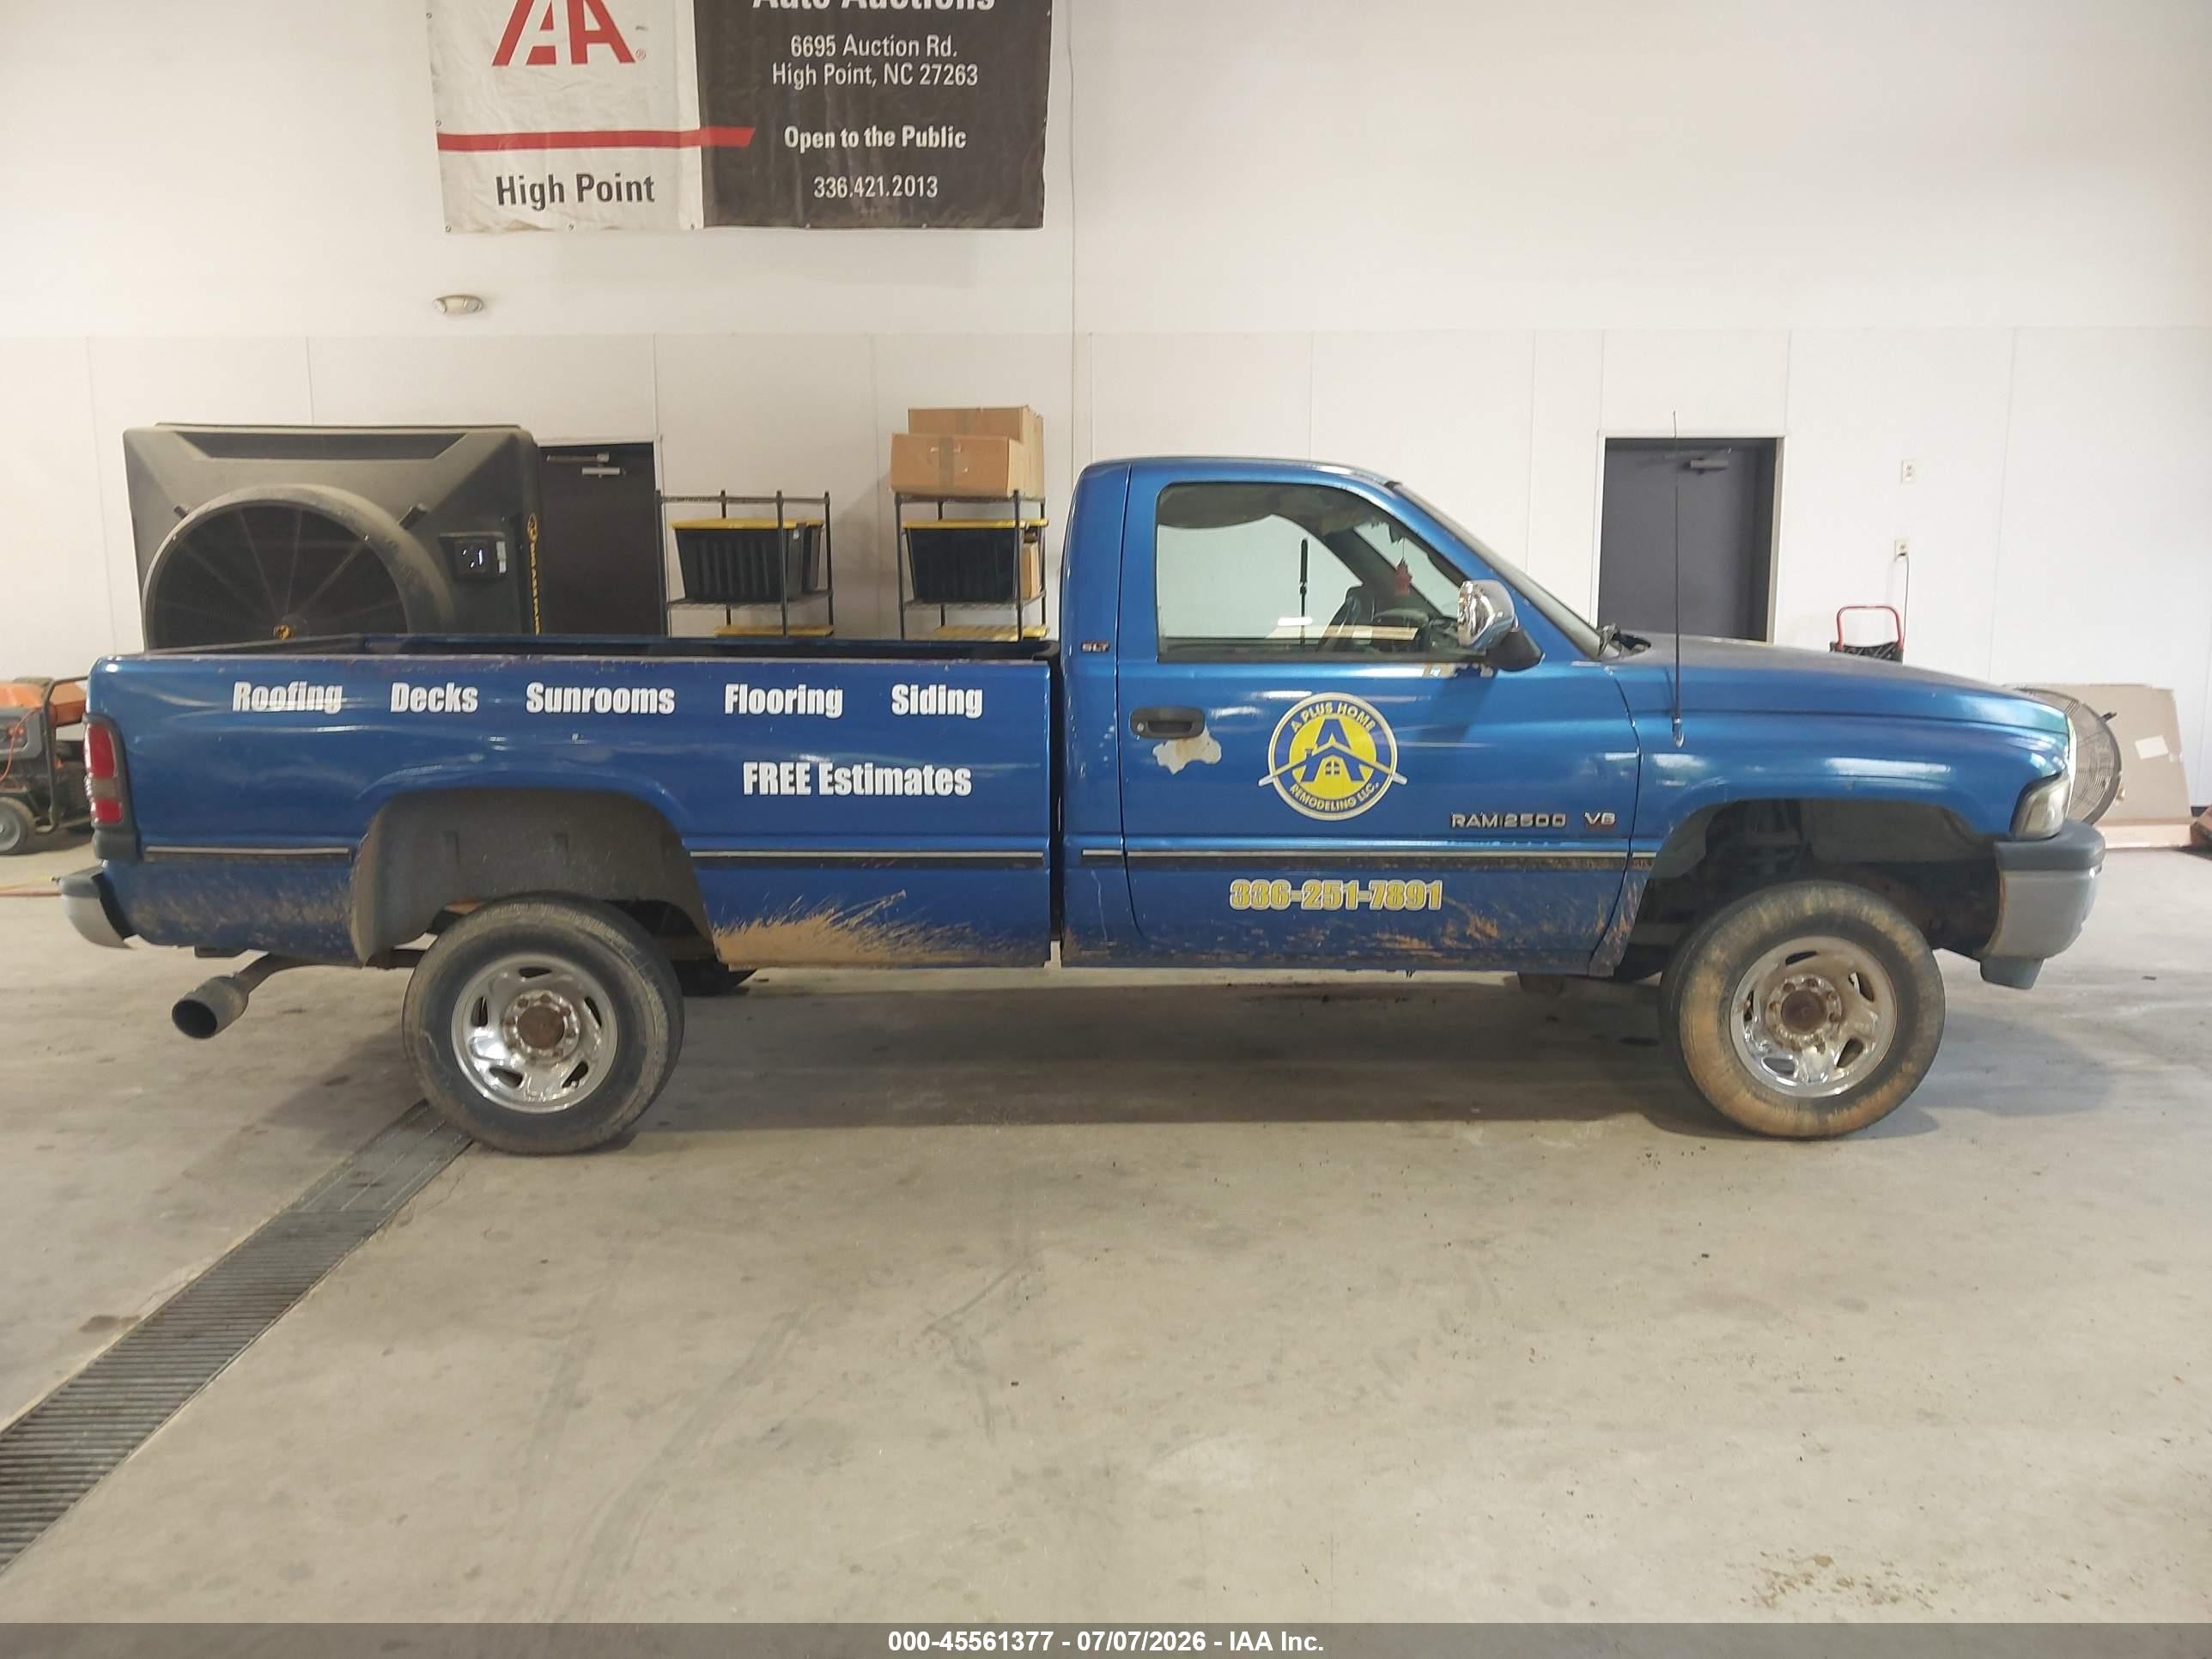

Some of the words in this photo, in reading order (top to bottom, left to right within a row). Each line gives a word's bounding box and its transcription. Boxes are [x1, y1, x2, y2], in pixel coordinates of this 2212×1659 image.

[790, 34, 836, 58] 6695
[842, 33, 920, 57] Auction
[926, 34, 957, 57] Rd.
[772, 62, 817, 90] High
[823, 62, 878, 88] Point,
[884, 62, 914, 85] NC
[919, 63, 978, 86] 27263
[784, 125, 836, 154] Open
[840, 128, 860, 148] to
[863, 125, 896, 148] the
[902, 125, 967, 149] Public
[495, 173, 565, 211] High
[575, 173, 655, 203] Point
[813, 175, 939, 198] 336.421.2013
[232, 681, 343, 714] Roofing
[390, 682, 478, 713] Decks
[526, 682, 675, 714] Sunrooms
[724, 684, 843, 719] Flooring
[890, 684, 983, 719] Siding
[1300, 702, 1334, 722] PLUS
[1337, 702, 1376, 732] HOME
[742, 762, 811, 796] FREE
[818, 762, 972, 796] Estimates
[1290, 782, 1357, 811] REMODELING
[1451, 812, 1498, 828] RAM
[1504, 813, 1566, 828] 2500
[1230, 878, 1443, 911] 336-251-7891
